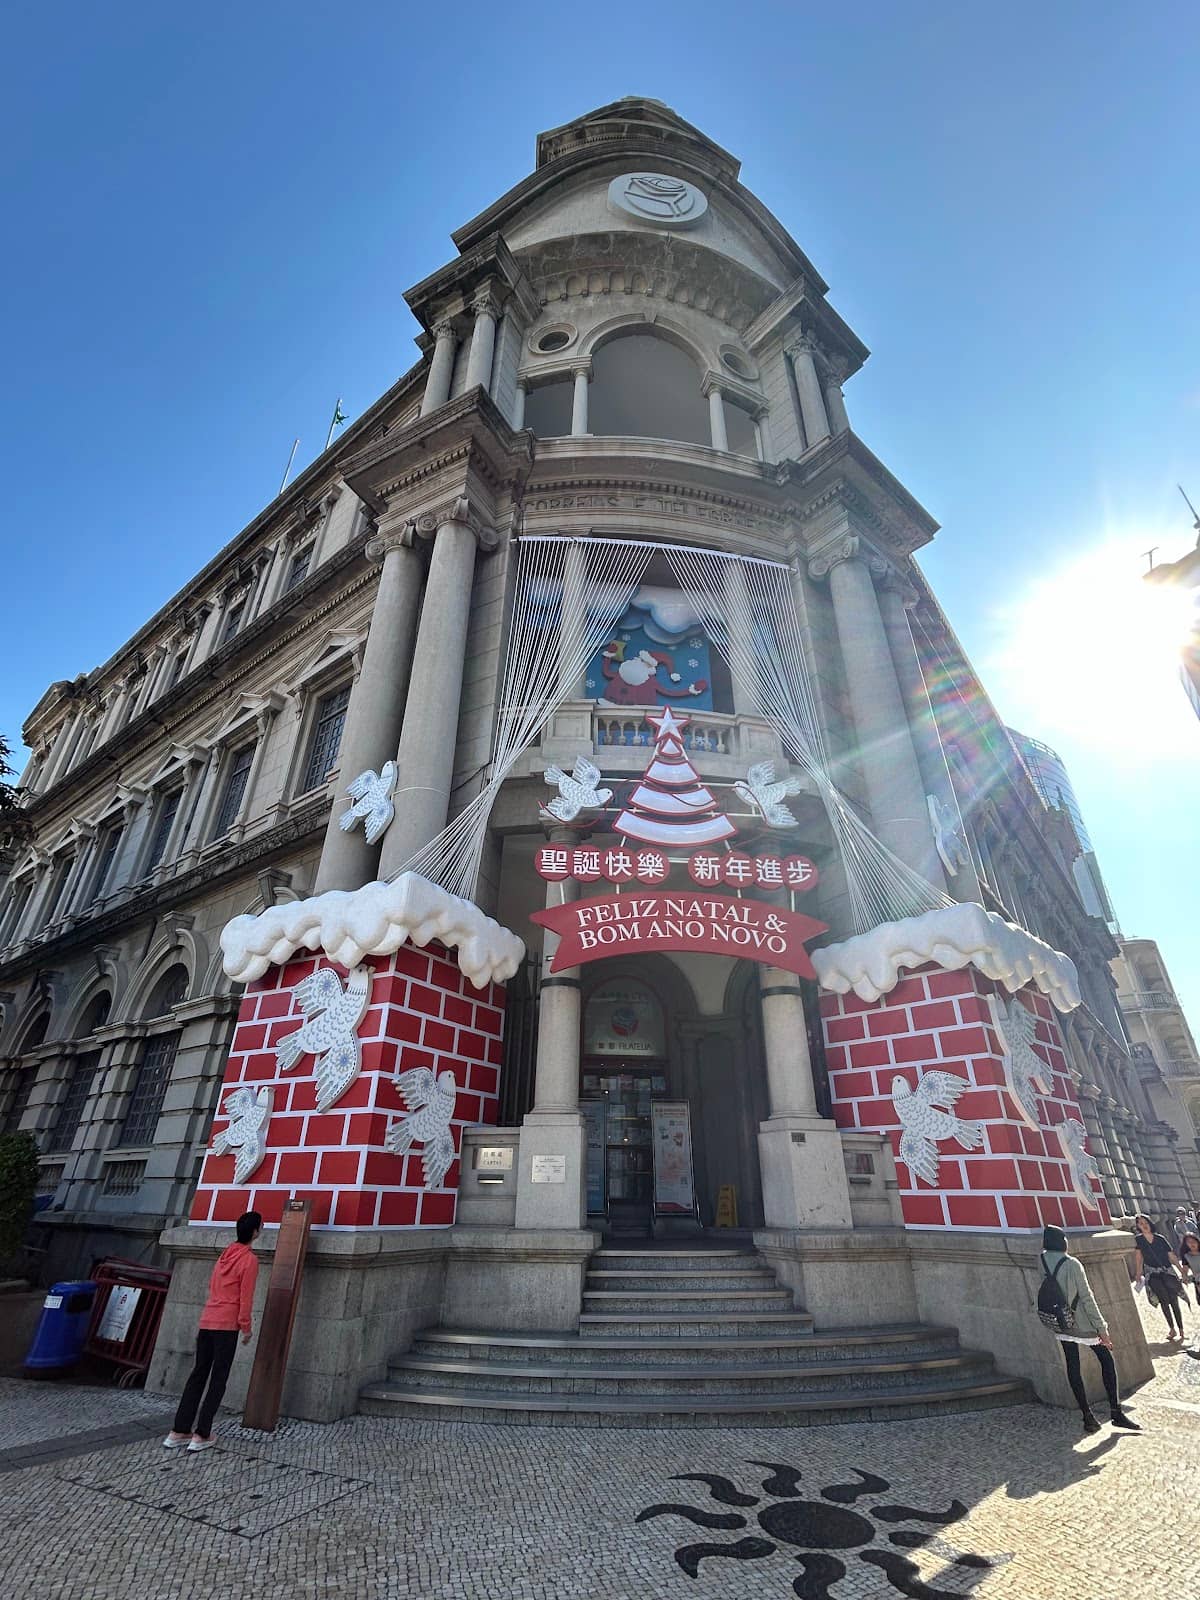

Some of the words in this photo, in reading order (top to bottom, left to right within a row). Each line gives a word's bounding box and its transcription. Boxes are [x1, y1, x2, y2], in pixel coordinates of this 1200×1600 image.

[540, 849, 666, 878] 聖誕快樂
[694, 855, 814, 884] 新年進步
[576, 899, 660, 928] FELIZ
[663, 899, 759, 927] NATAL
[765, 913, 788, 934] &
[578, 921, 641, 950] BOM
[647, 920, 705, 938] ANO
[711, 922, 788, 954] NOVO
